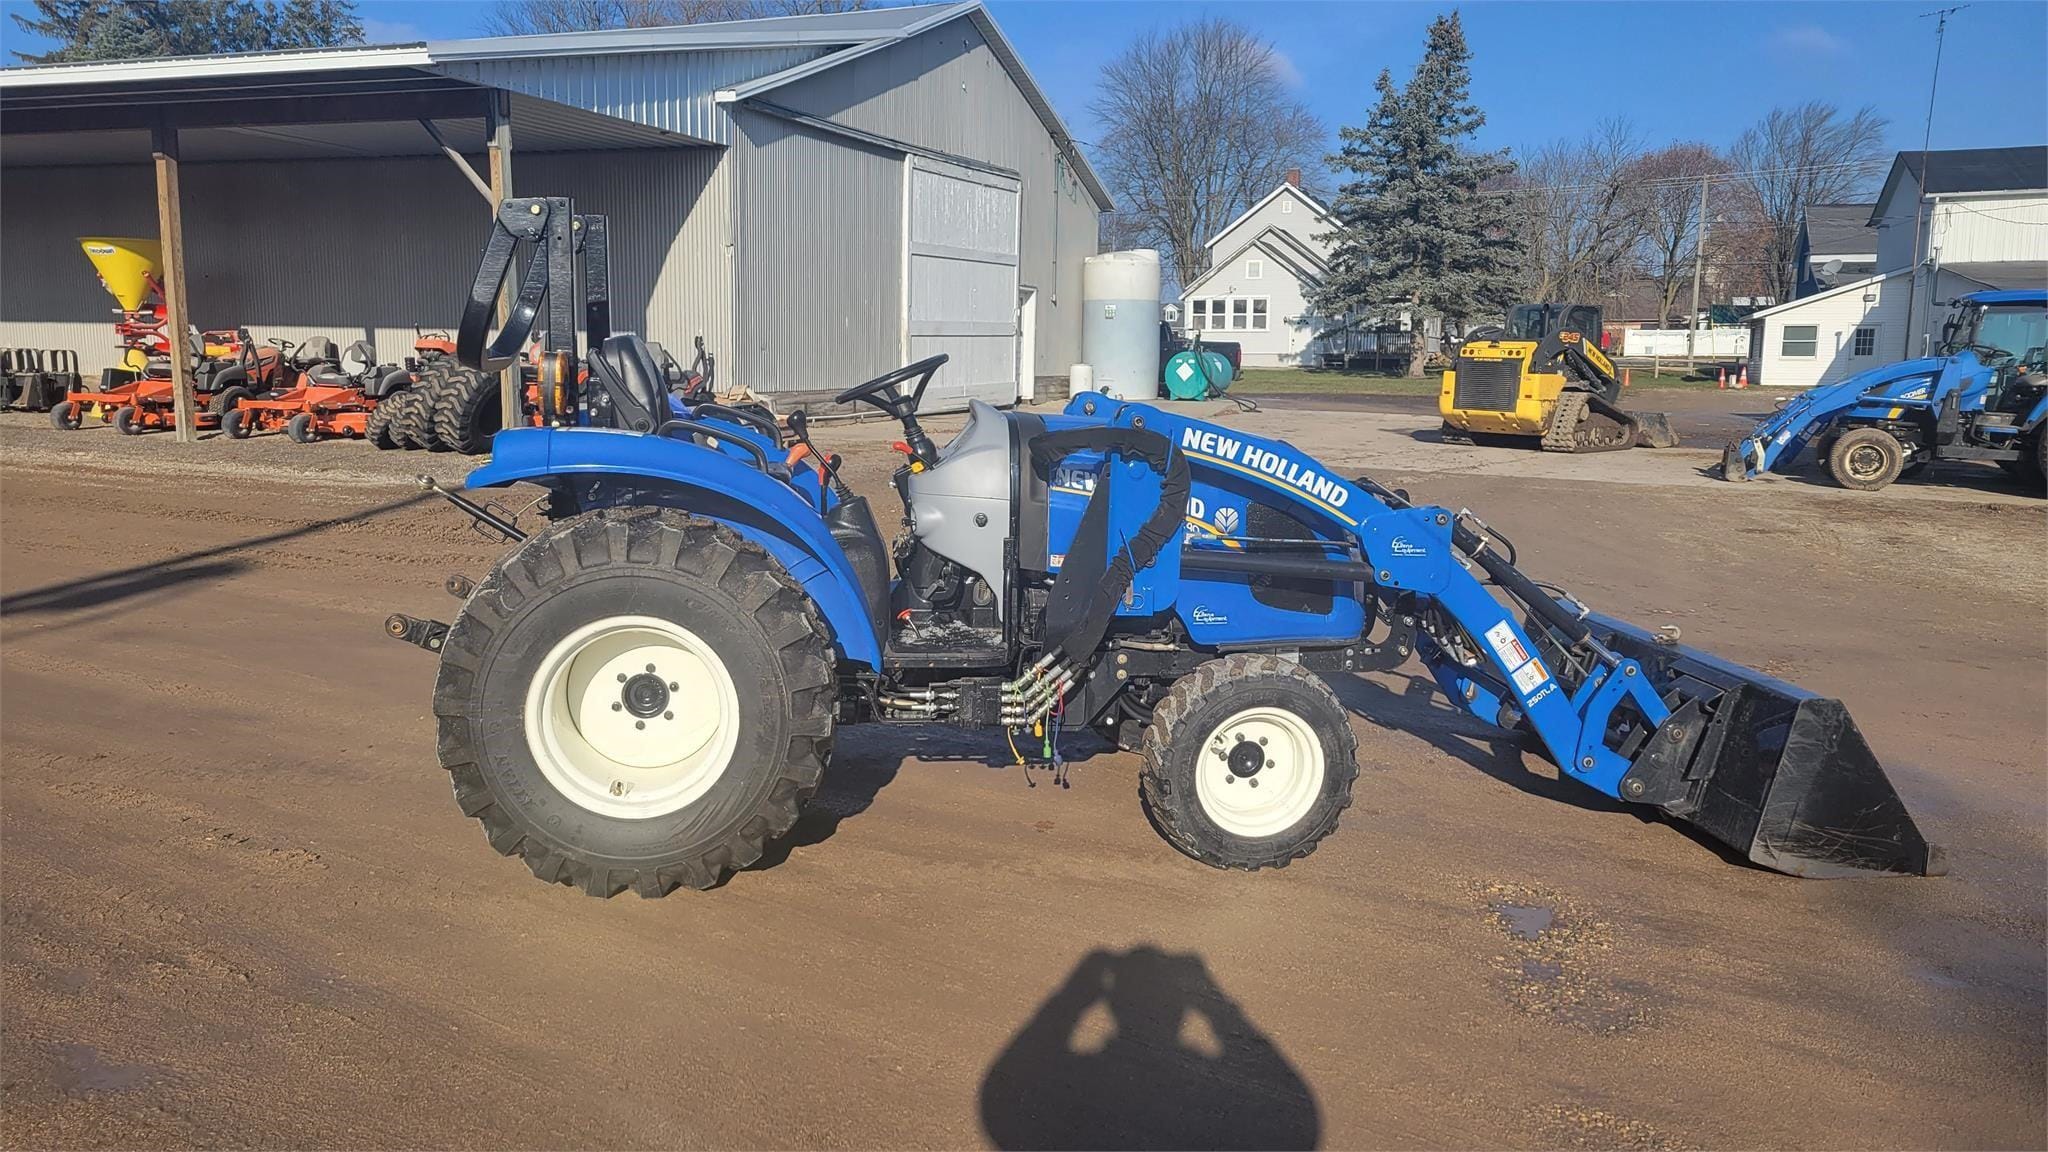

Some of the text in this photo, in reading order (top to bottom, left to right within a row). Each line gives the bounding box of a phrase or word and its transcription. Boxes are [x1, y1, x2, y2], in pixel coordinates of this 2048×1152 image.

[1182, 427, 1348, 507] NEW HOLLAND
[1526, 683, 1557, 707] 250TLA
